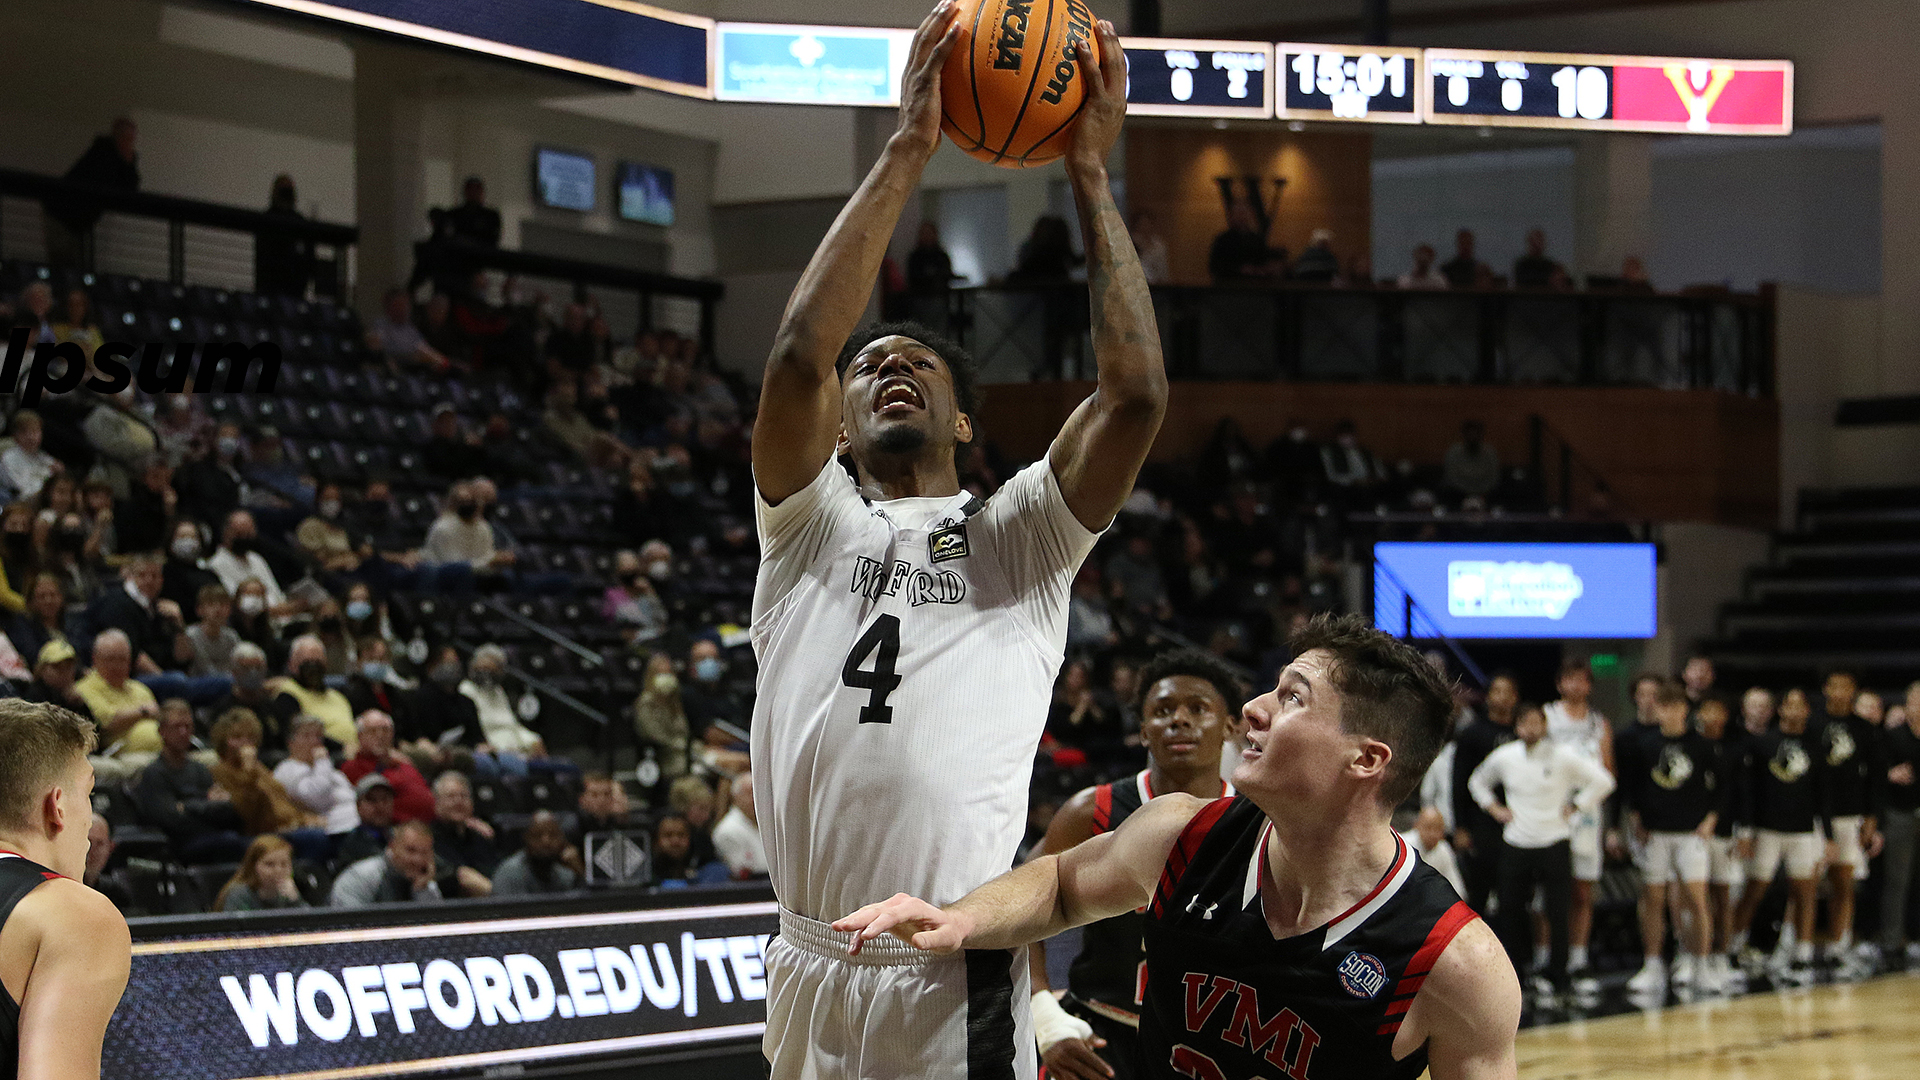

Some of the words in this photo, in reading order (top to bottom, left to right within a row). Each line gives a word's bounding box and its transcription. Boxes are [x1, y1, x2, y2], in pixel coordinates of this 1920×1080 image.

[1291, 52, 1406, 98] 15:01
[1551, 66, 1608, 119] 10
[842, 613, 902, 724] 4
[219, 931, 770, 1049] WOFFORD.EDU/TE
[1339, 953, 1386, 995] SOCON
[1181, 972, 1321, 1080] VMI
